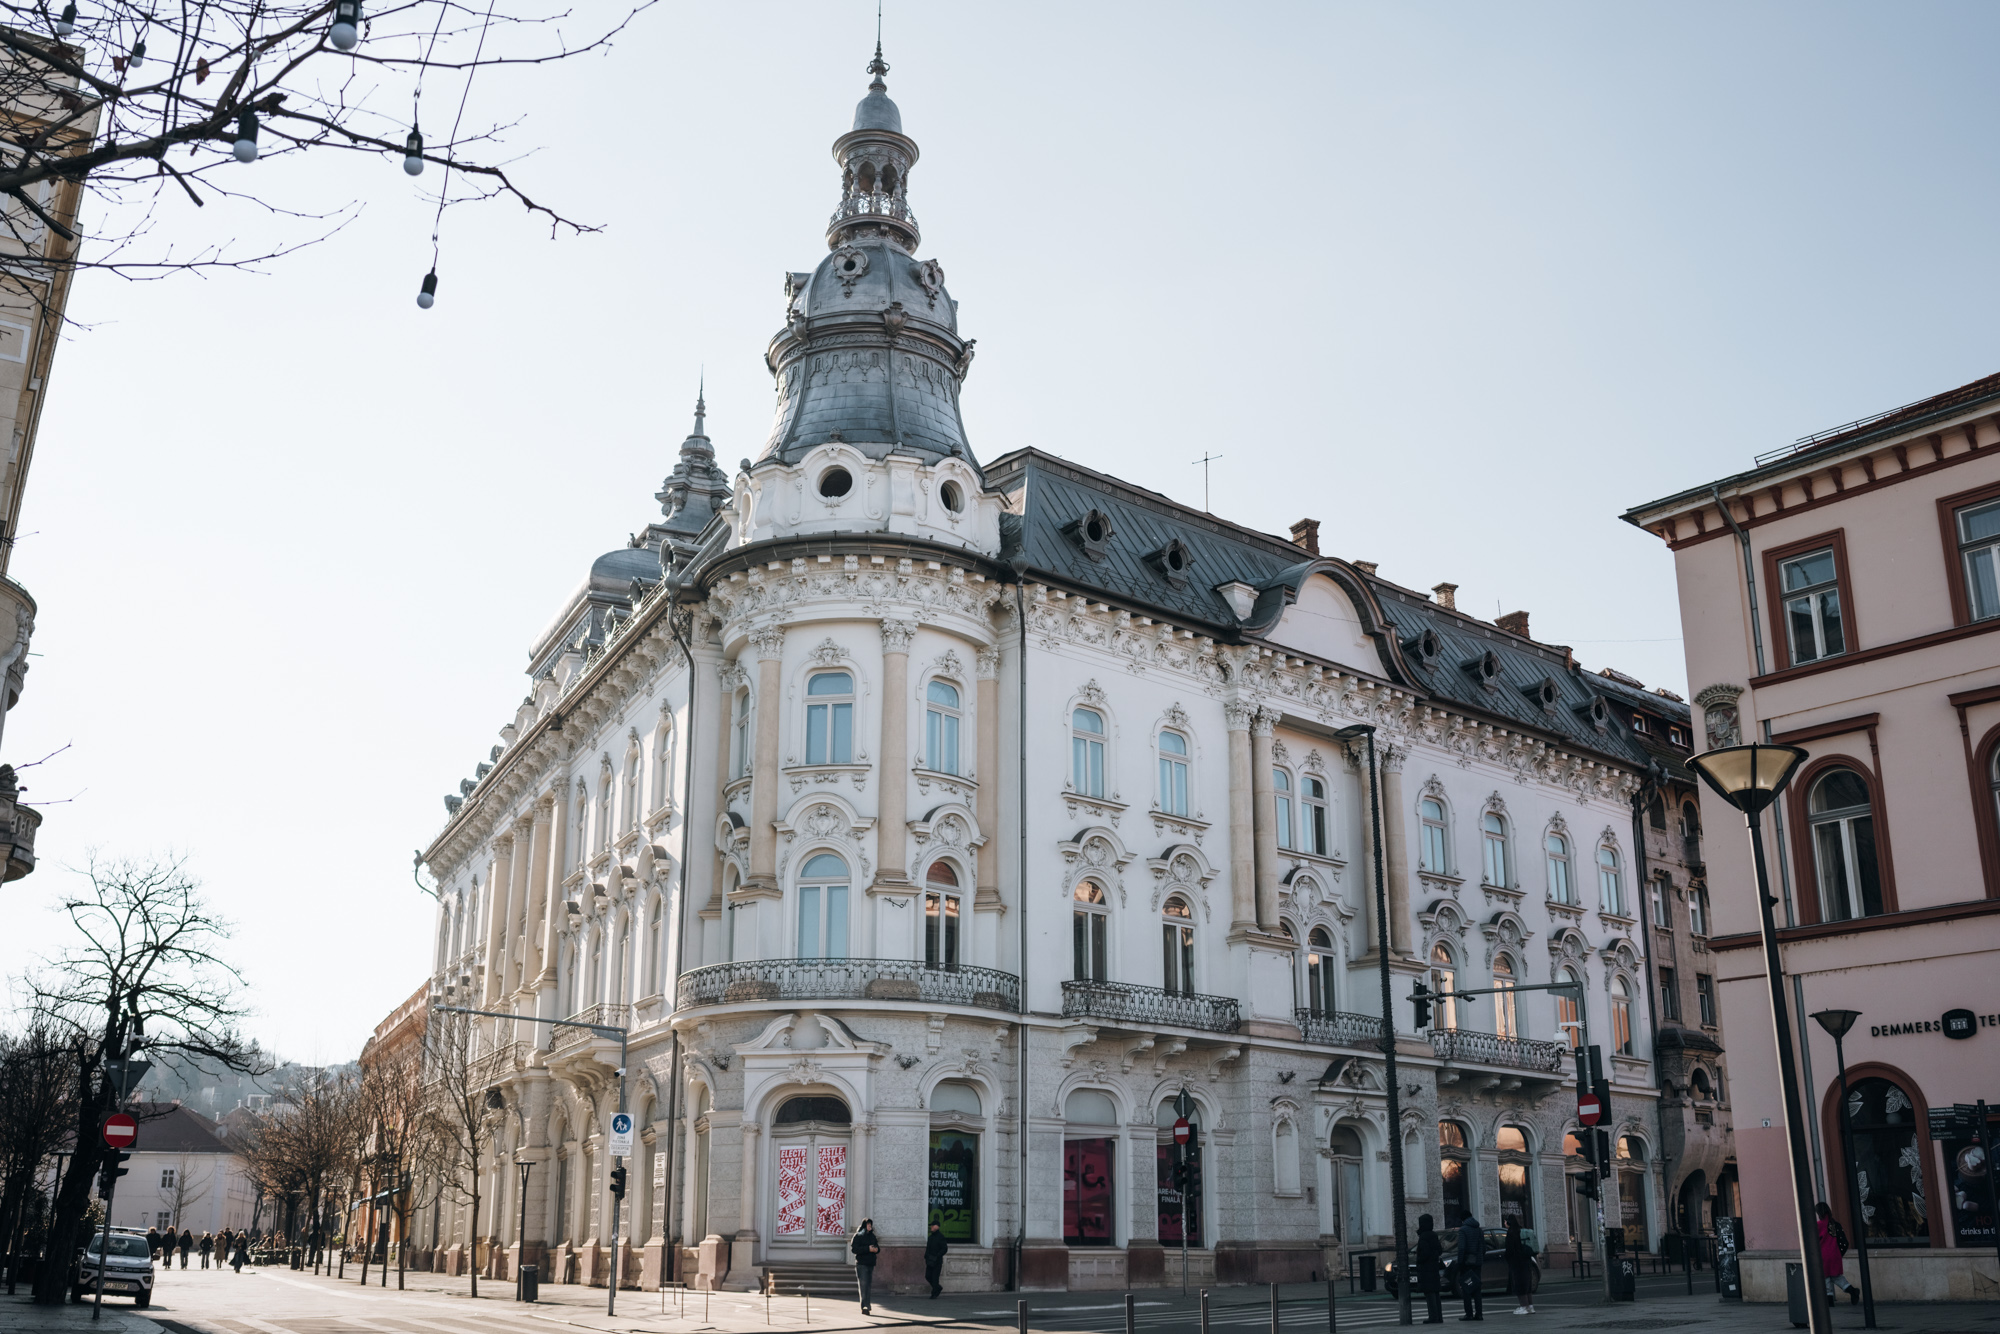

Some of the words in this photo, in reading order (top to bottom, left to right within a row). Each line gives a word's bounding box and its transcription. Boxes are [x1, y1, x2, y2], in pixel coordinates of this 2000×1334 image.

[1871, 1021, 1940, 1037] DEMMERS
[1978, 1014, 2000, 1027] TE
[781, 1149, 806, 1158] ELECTR
[781, 1157, 806, 1167] CASTLE
[946, 1163, 959, 1171] IDEE
[931, 1171, 939, 1179] CE
[940, 1171, 947, 1179] TE
[948, 1172, 959, 1180] MAI
[1960, 1227, 1982, 1235] drinks
[1983, 1227, 1990, 1235] in
